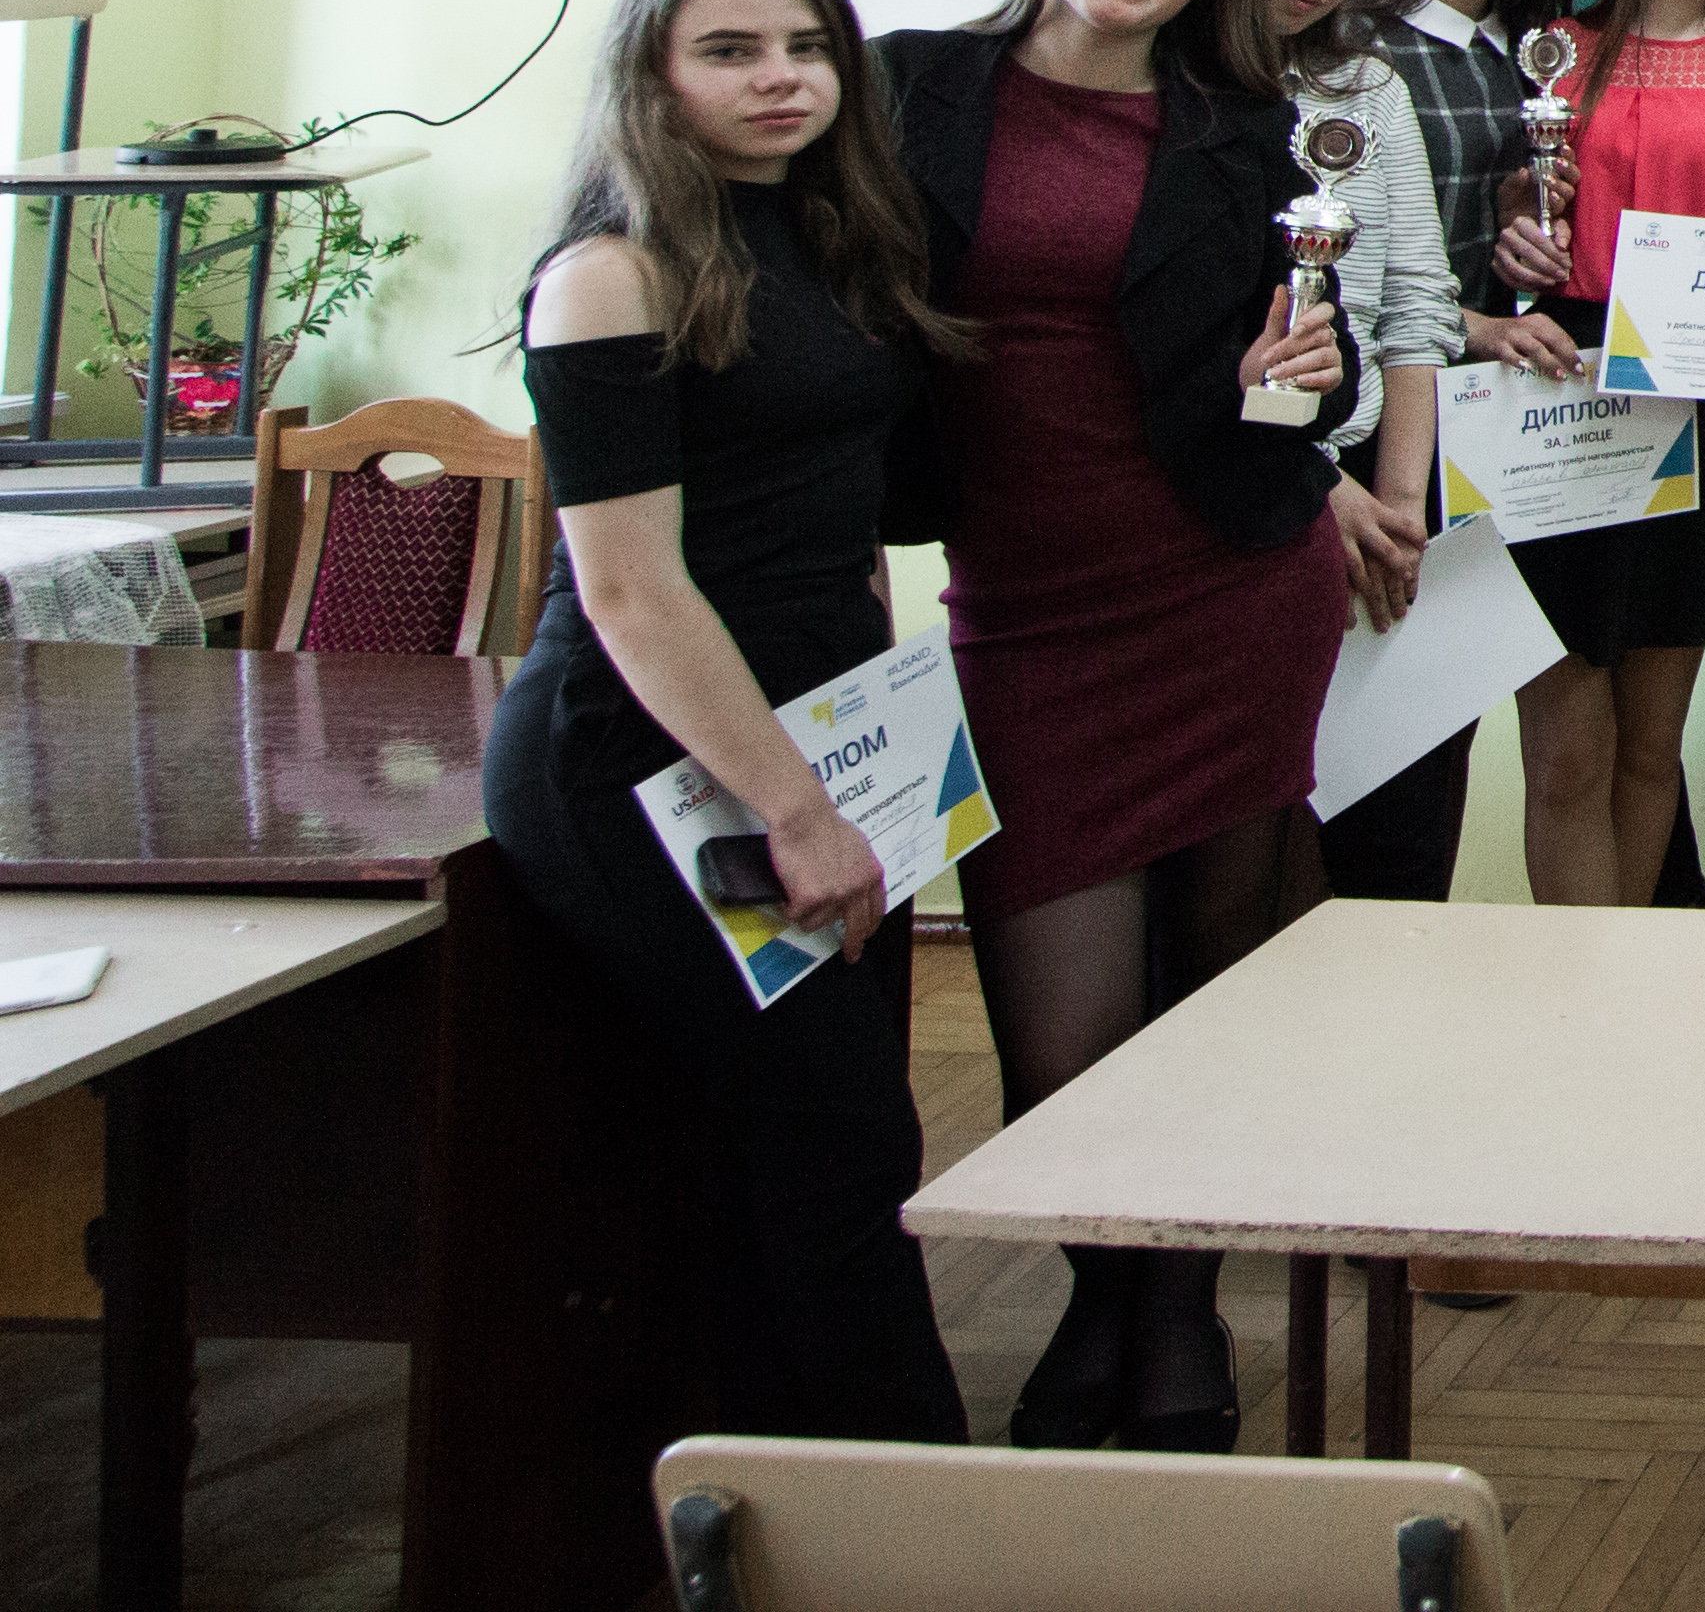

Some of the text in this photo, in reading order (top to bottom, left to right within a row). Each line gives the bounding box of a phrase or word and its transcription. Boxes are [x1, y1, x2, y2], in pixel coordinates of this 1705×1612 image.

[1634, 237, 1670, 249] USAID
[1454, 389, 1492, 402] USAID
[1521, 395, 1631, 435] ДИПЛОМ
[1572, 428, 1613, 446] МІСЦЕ
[1510, 460, 1556, 475] дебатному
[1558, 455, 1586, 467] турнірі
[1587, 444, 1654, 461] нагороджується
[671, 784, 716, 816] USAID
[856, 774, 928, 824] нагороджується
